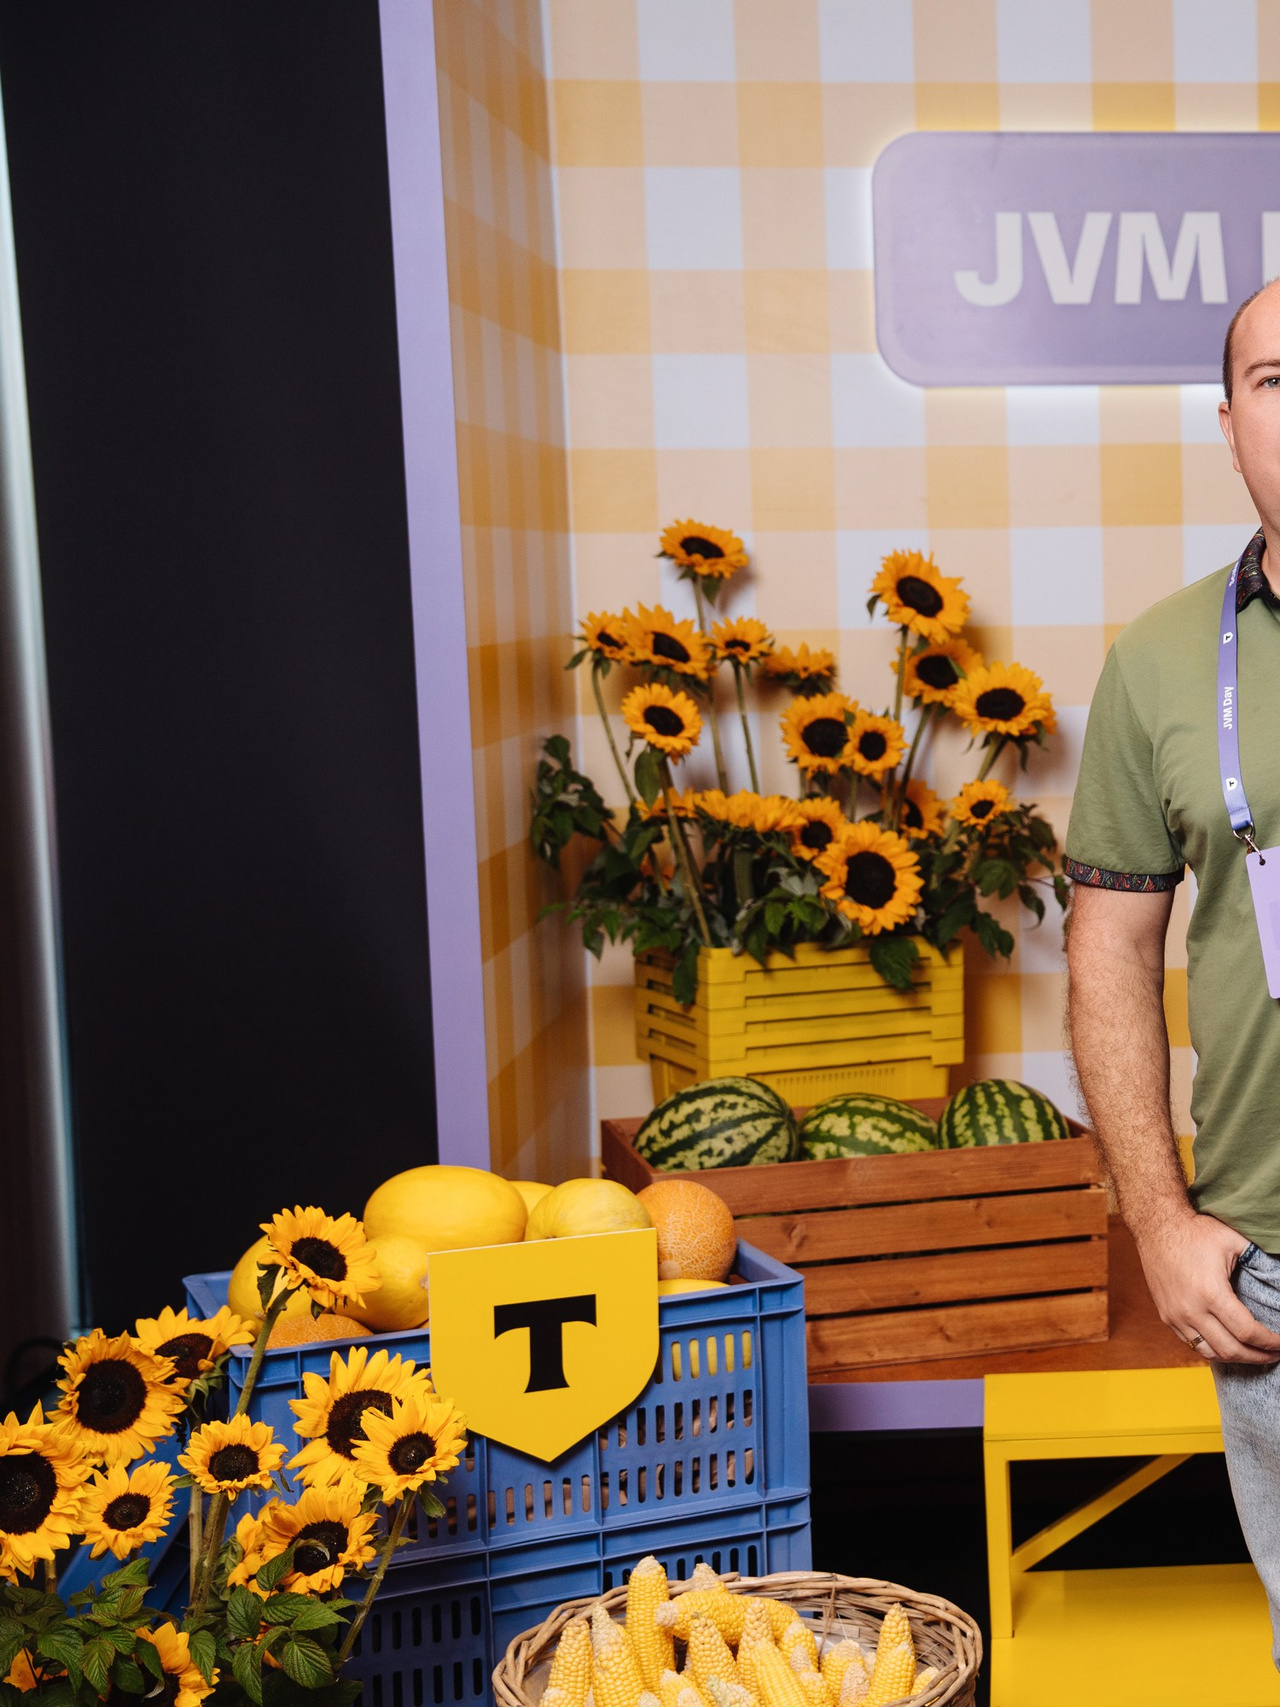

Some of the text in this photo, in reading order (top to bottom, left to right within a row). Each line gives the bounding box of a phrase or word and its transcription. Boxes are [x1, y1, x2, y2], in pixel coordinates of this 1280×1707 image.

[954, 212, 1229, 306] JVM
[1223, 686, 1235, 730] JVM Day
[493, 1293, 597, 1393] T
